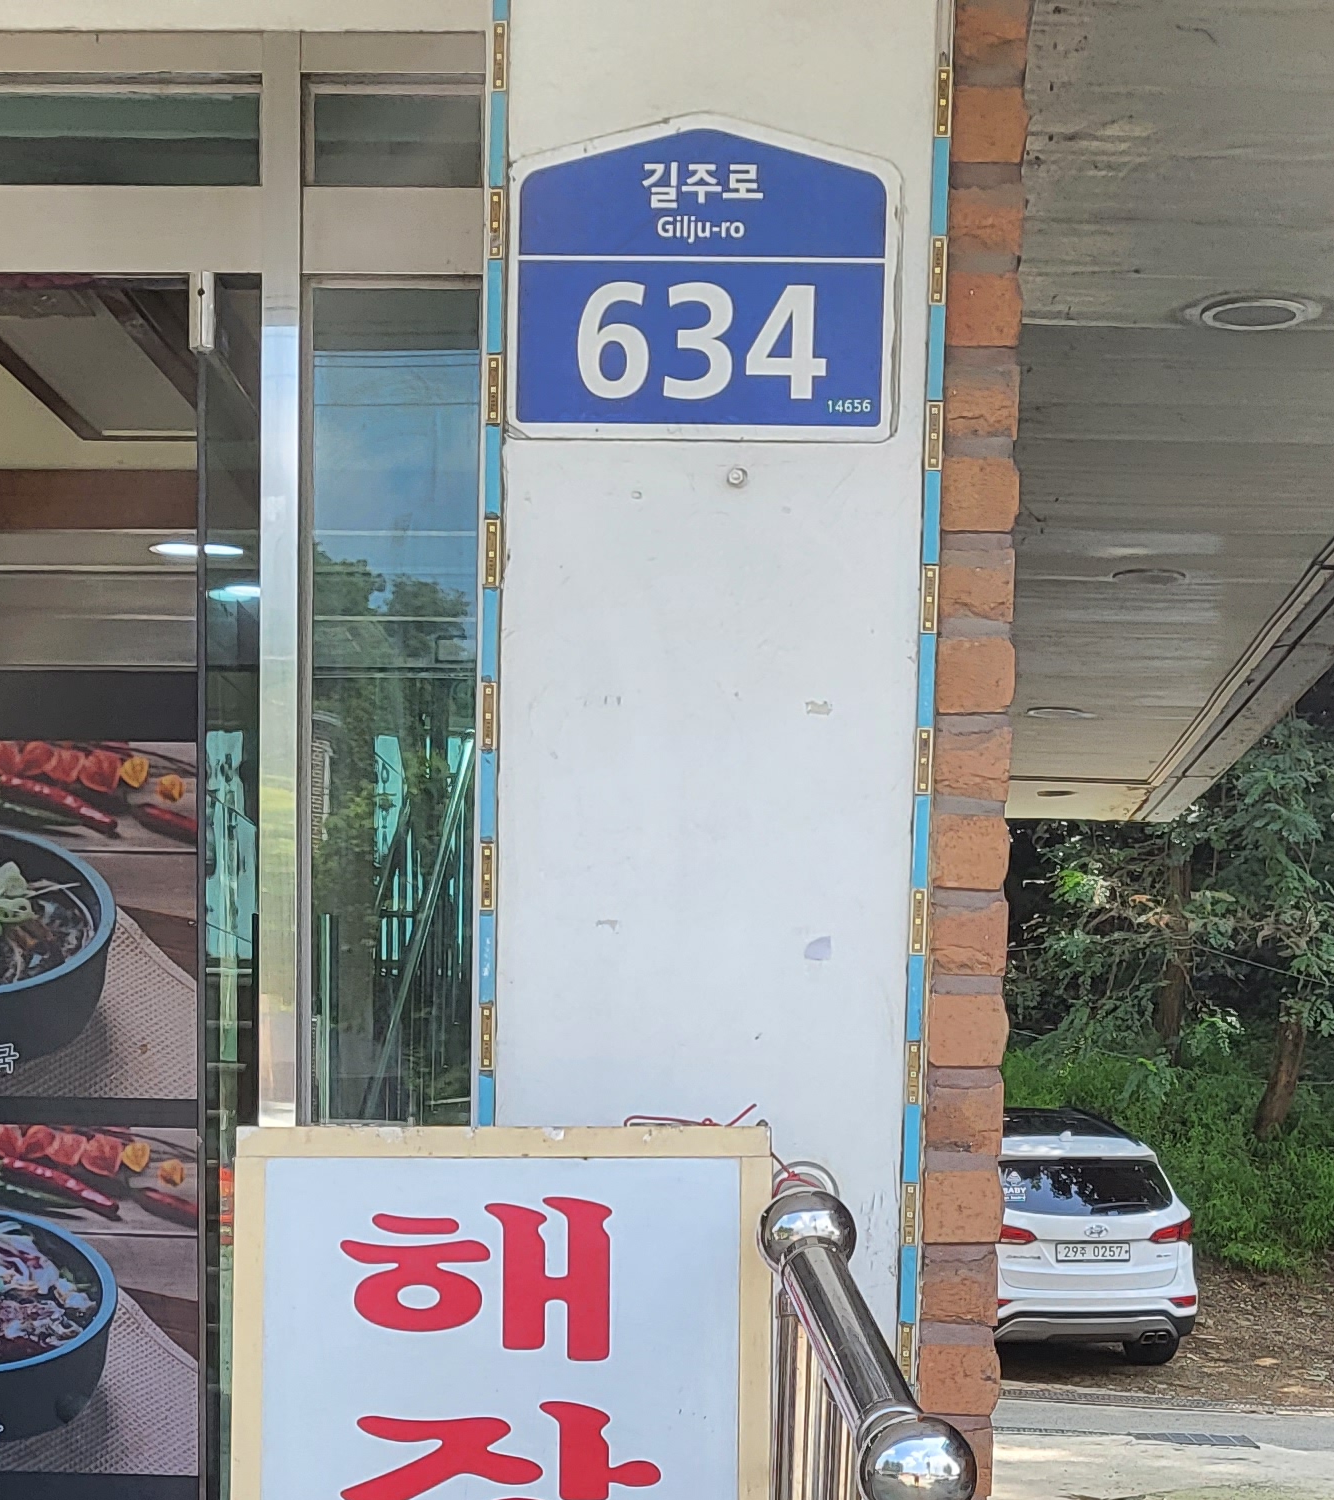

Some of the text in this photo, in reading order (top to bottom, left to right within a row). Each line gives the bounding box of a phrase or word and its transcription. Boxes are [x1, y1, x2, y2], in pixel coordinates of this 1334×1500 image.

[642, 161, 764, 209] 길주로
[657, 216, 745, 243] Gilju-ro
[577, 281, 827, 401] 634
[827, 399, 872, 413] 14656
[1063, 1245, 1124, 1258] 29주 0257
